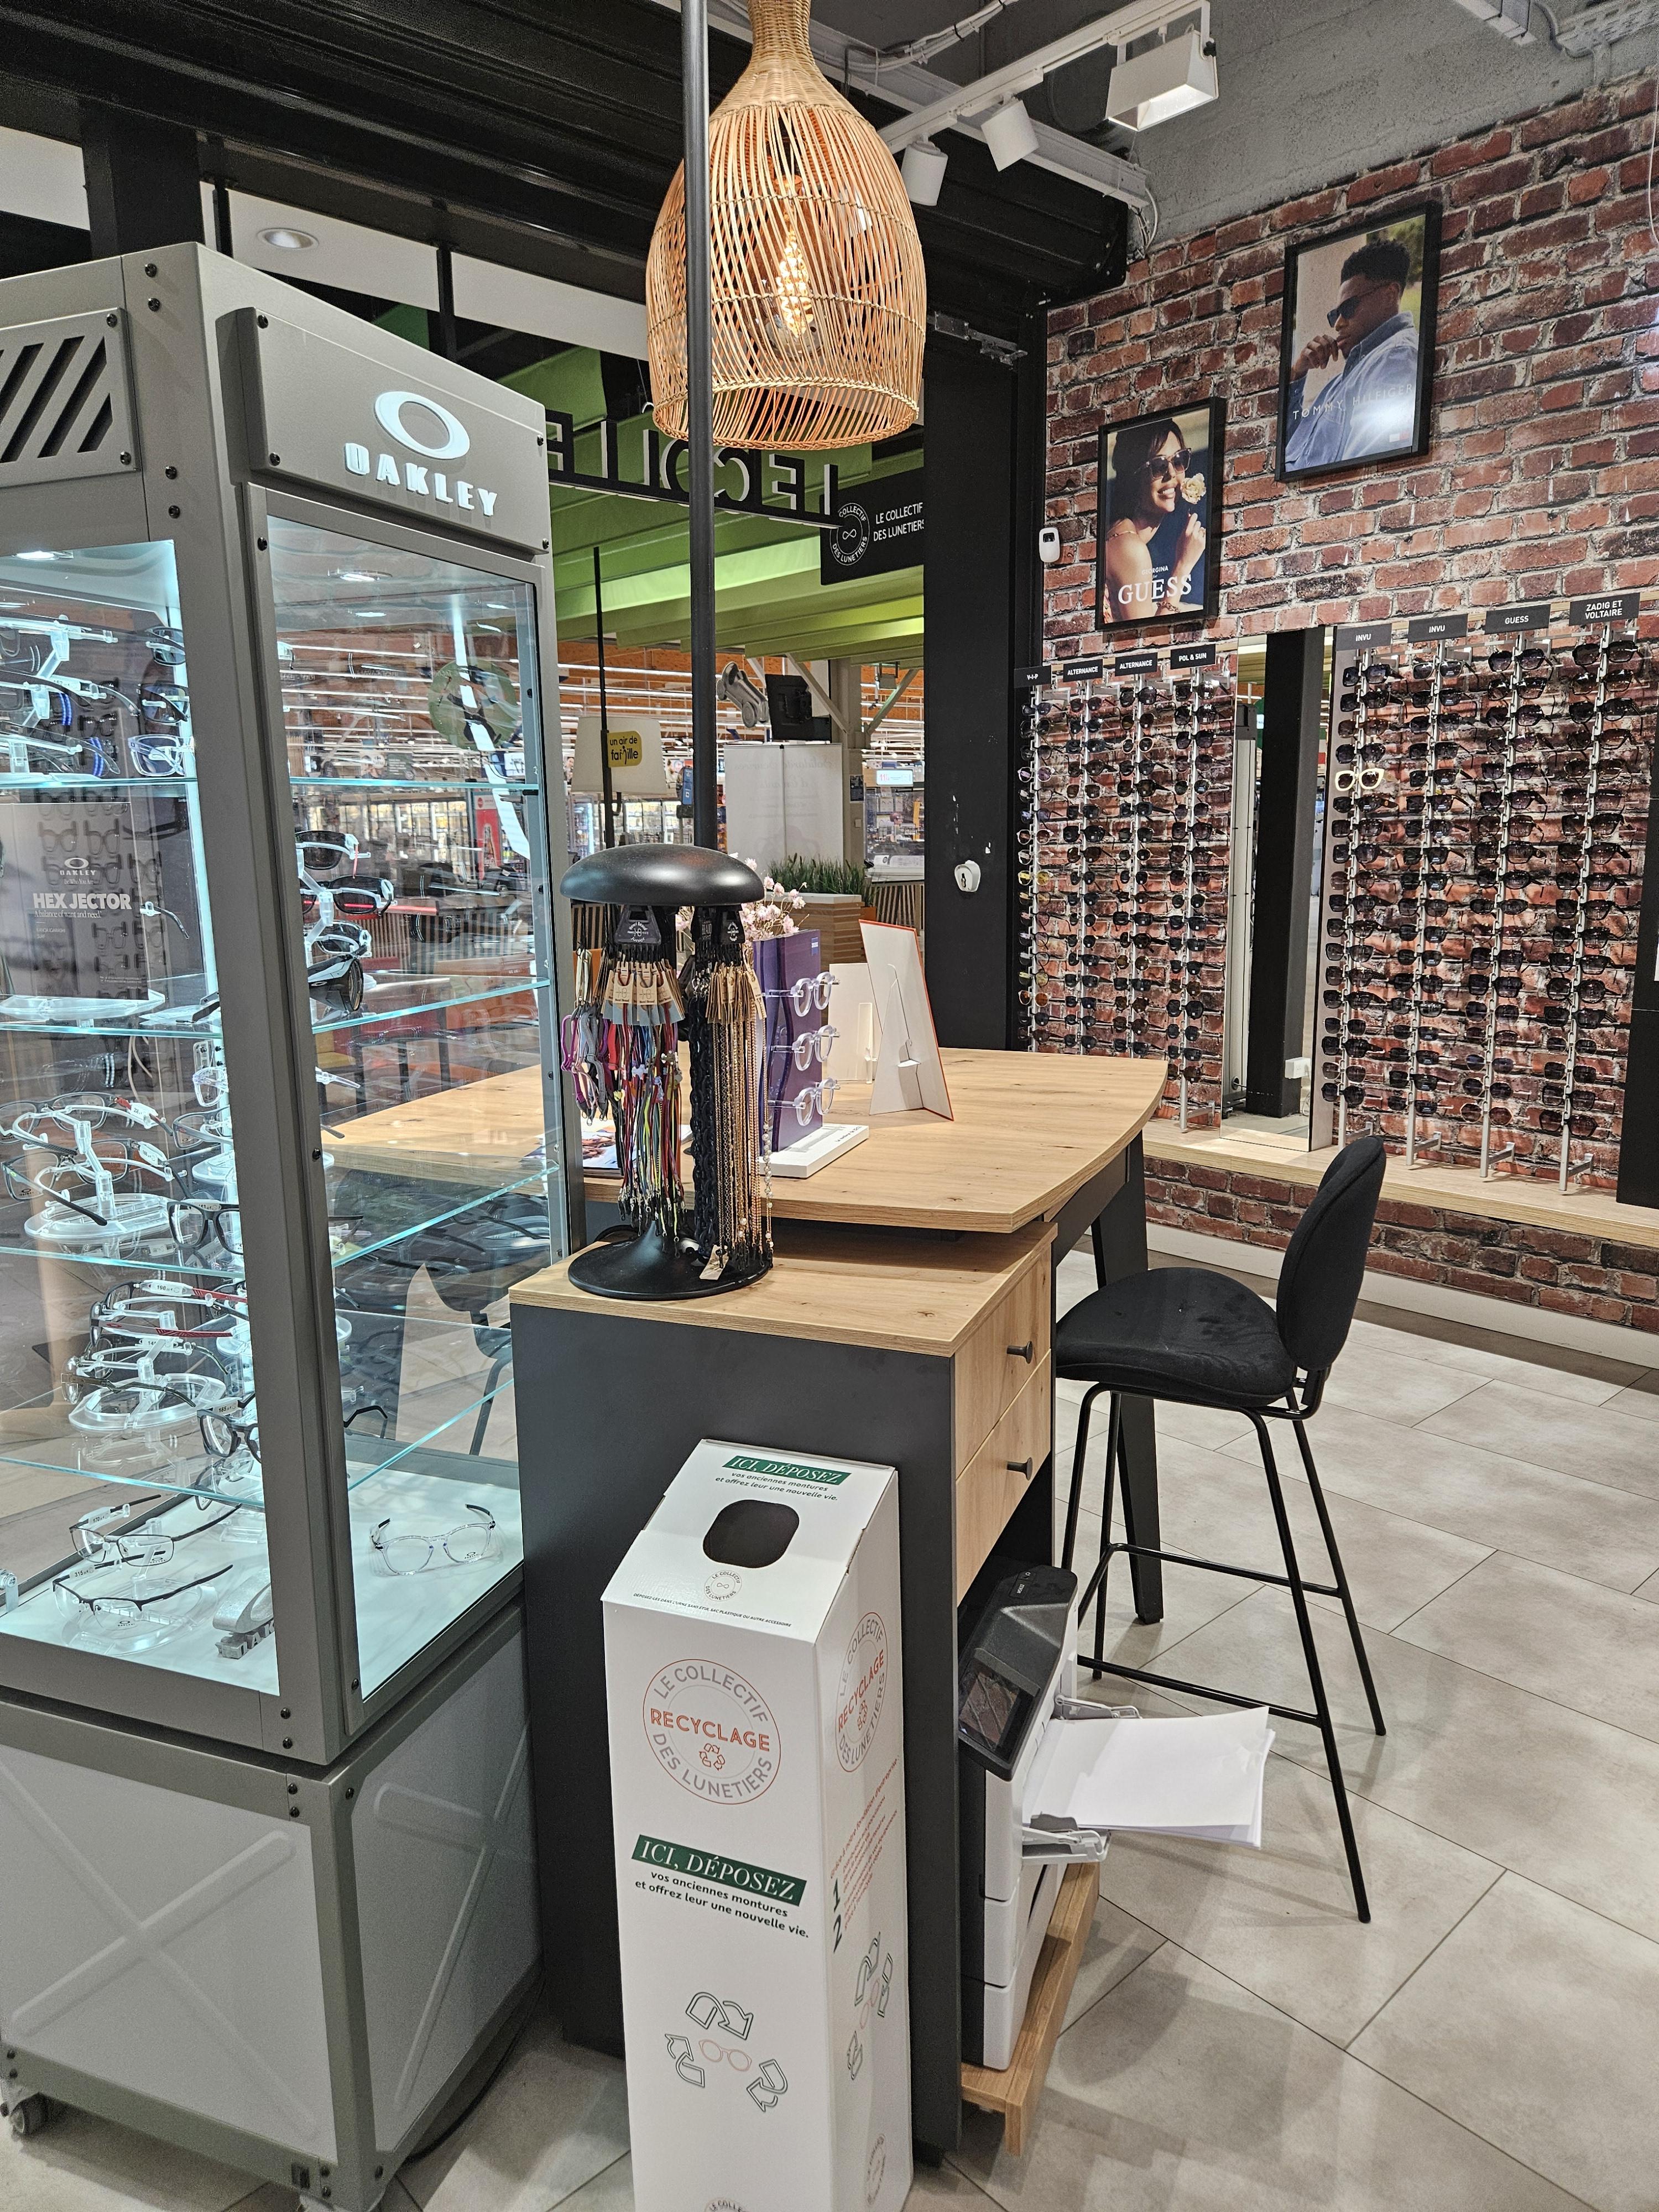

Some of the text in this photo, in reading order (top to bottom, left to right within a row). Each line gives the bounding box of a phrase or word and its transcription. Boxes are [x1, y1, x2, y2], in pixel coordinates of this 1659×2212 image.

[1293, 384, 1412, 420] TOMMY HILFIGER
[345, 442, 498, 516] OAKLEY
[839, 505, 867, 522] COLLECTIF
[875, 502, 923, 524] LE COLLECTIF
[873, 529, 886, 542] DES
[841, 536, 868, 563] LUNETIERS
[1142, 565, 1168, 575] GEORGINA
[1118, 574, 1192, 604] GUESS
[1585, 608, 1623, 619] VOLTAIRE
[1586, 600, 1623, 612] ZADIG ET
[1428, 624, 1446, 633] INVU
[1505, 615, 1529, 624] GUESS
[1355, 633, 1371, 642] INVU
[1119, 660, 1152, 670] ALTERNANCE
[1195, 652, 1207, 660] SUN
[1067, 666, 1098, 676] ALTERNANCE
[619, 736, 628, 745] air
[629, 735, 638, 744] de
[611, 745, 638, 765] famille
[33, 893, 132, 910] HEX JECTOR
[730, 1458, 842, 1483] ICI, DÉPOSEZ
[747, 1475, 786, 1485] anciennes
[788, 1481, 828, 1491] montures
[786, 1488, 822, 1499] nouvelle
[719, 1571, 740, 1584] COLLECTIF
[709, 1590, 737, 1601] LUNETIERS
[840, 1619, 883, 1696] LE COLLECTIF
[654, 1666, 768, 1723] LE COLLECTIF
[838, 1648, 884, 1733] RECYCLAGE
[839, 1672, 885, 1765] DES LUNETIERS
[650, 1708, 770, 1752] RECYCLAGE
[653, 1733, 773, 1798] DES LUNETIERS
[640, 1840, 796, 1900] ICI, DÉPOSEZ
[651, 1871, 788, 1917] vos anciennes montures
[833, 1878, 841, 1913] 1
[635, 1881, 809, 1938] et offrez leur une nouvelle vie.
[833, 1914, 842, 1954] 2
